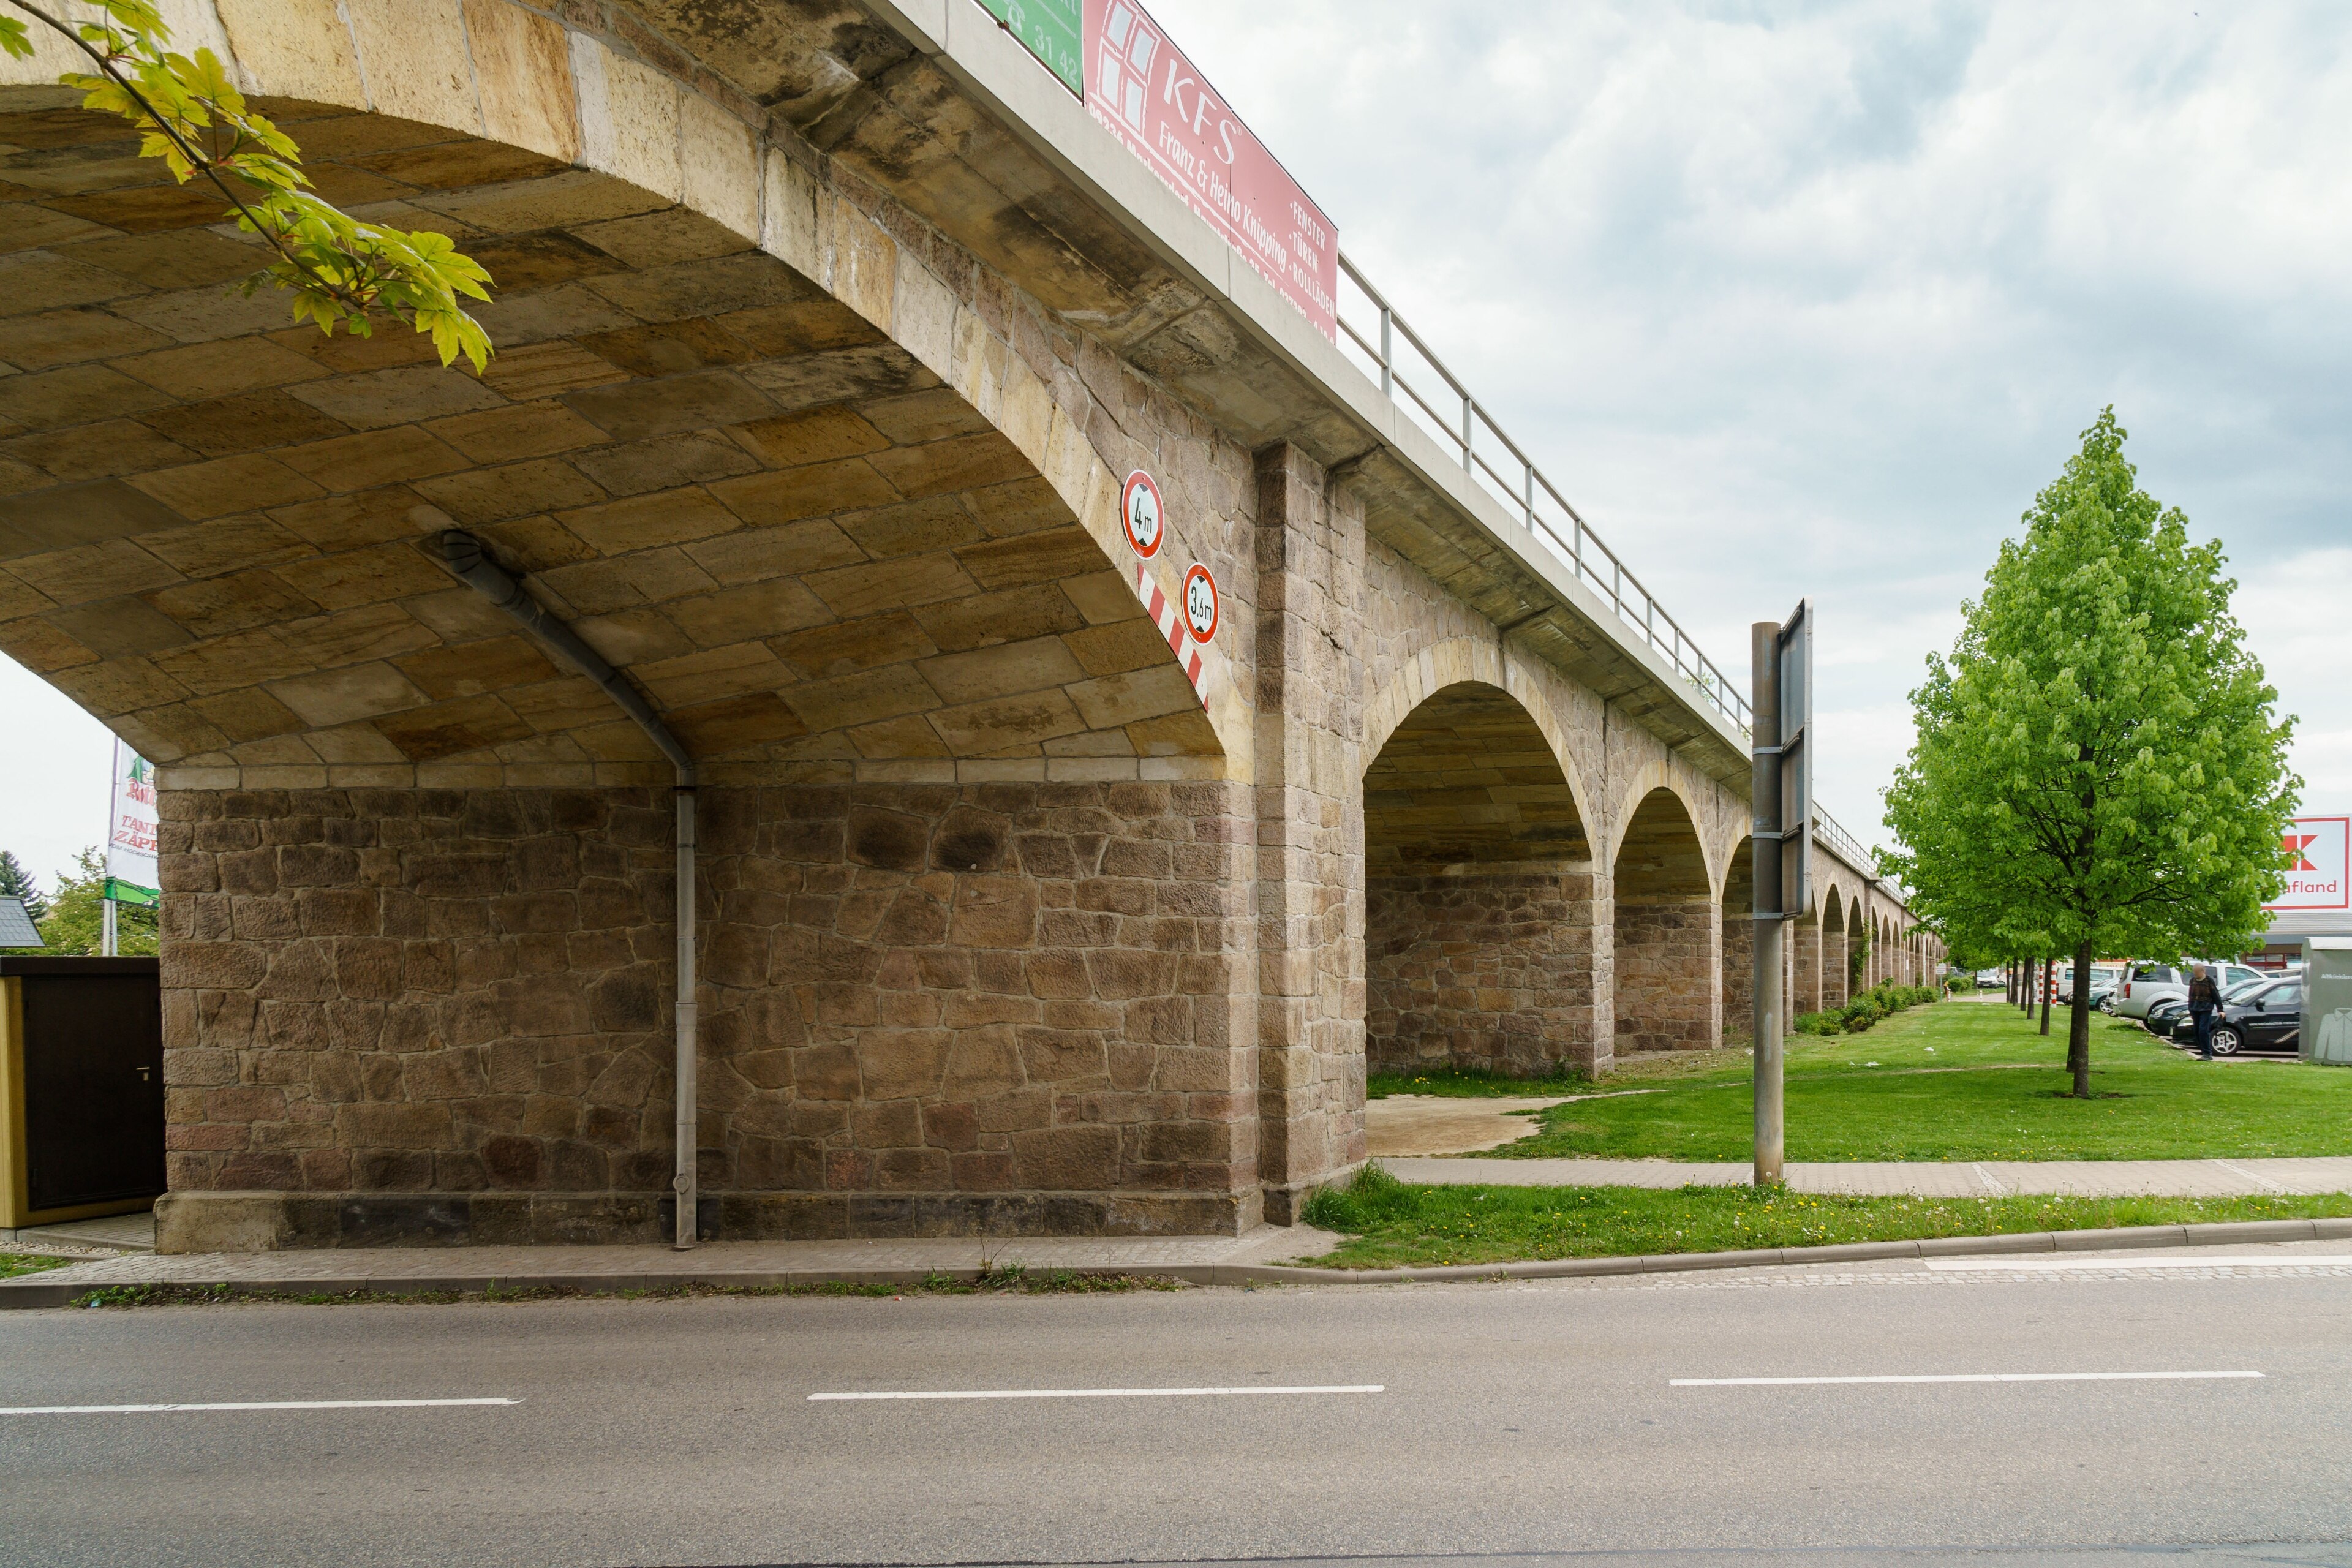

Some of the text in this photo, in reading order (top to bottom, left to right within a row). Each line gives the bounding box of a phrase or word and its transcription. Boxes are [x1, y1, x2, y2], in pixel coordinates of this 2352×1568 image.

[1159, 121, 1287, 273] Franz & Heino Knipping
[1292, 230, 1318, 273] TÜREN
[1293, 200, 1325, 252] FENSTER
[1293, 262, 1335, 320] ROLLLÄDEN
